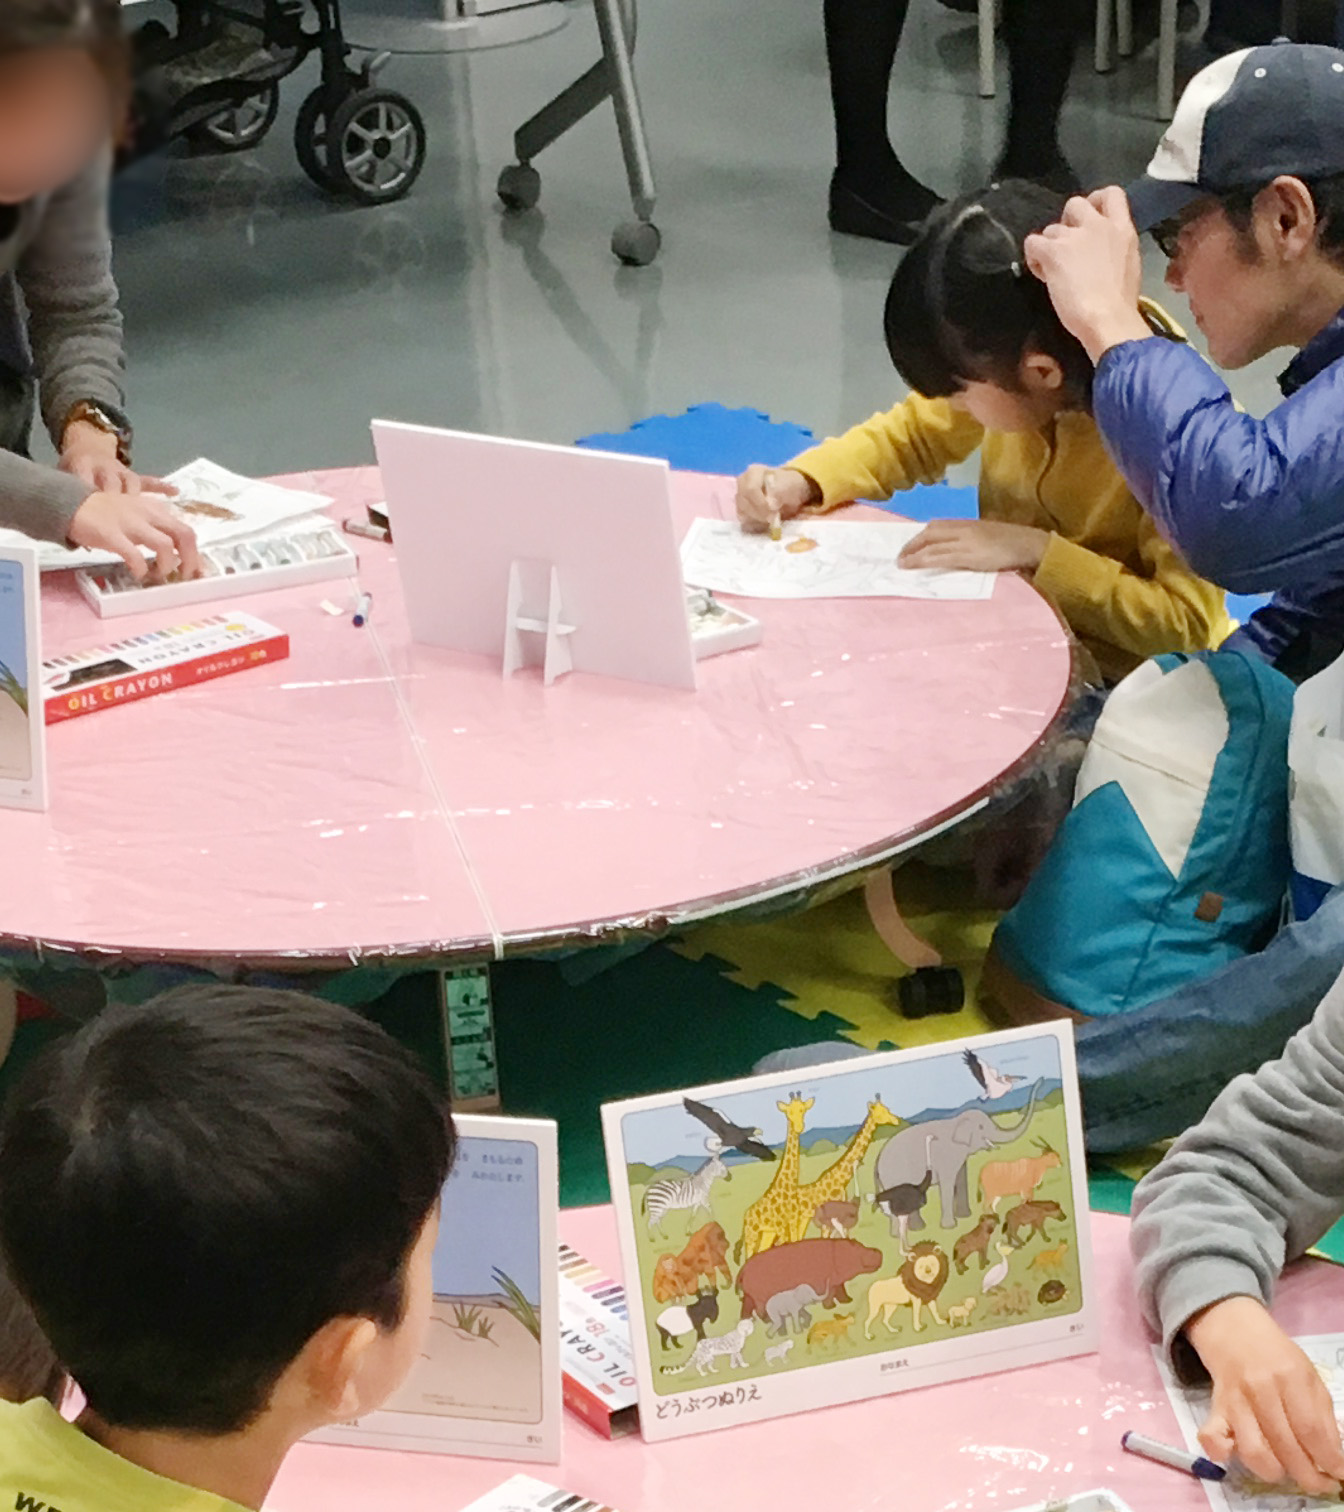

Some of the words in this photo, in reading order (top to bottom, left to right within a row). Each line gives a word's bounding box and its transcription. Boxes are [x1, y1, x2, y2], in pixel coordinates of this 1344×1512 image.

[68, 692, 98, 711] OIL
[103, 670, 174, 702] CRAYON
[655, 1383, 763, 1420] どうぶつぬりえ
